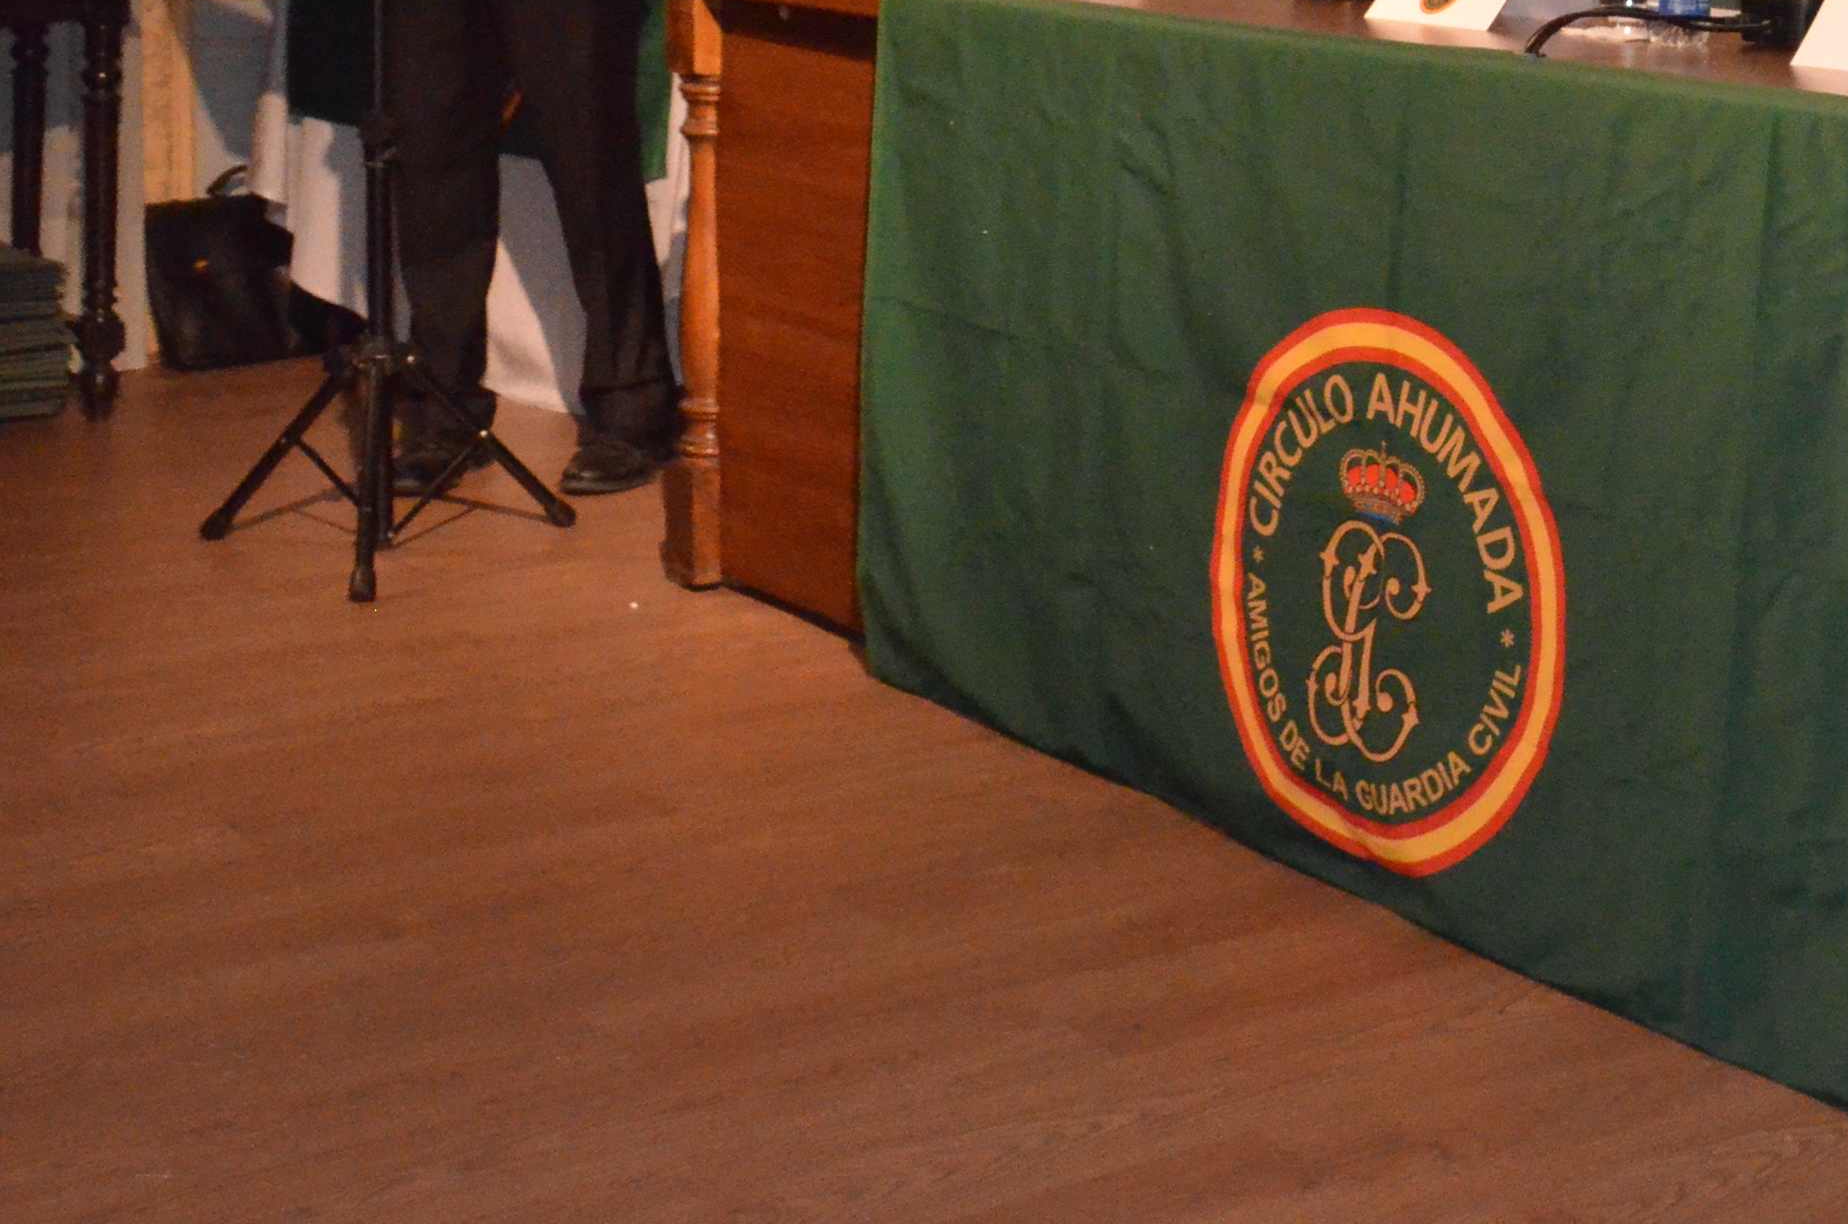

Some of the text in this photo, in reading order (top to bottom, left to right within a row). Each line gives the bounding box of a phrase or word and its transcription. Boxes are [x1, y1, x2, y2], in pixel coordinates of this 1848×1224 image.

[1249, 372, 1524, 616] CIRCULO AHUMADA
[1245, 572, 1522, 816] AMIGOS DE LA GUARDIA CIVIL
